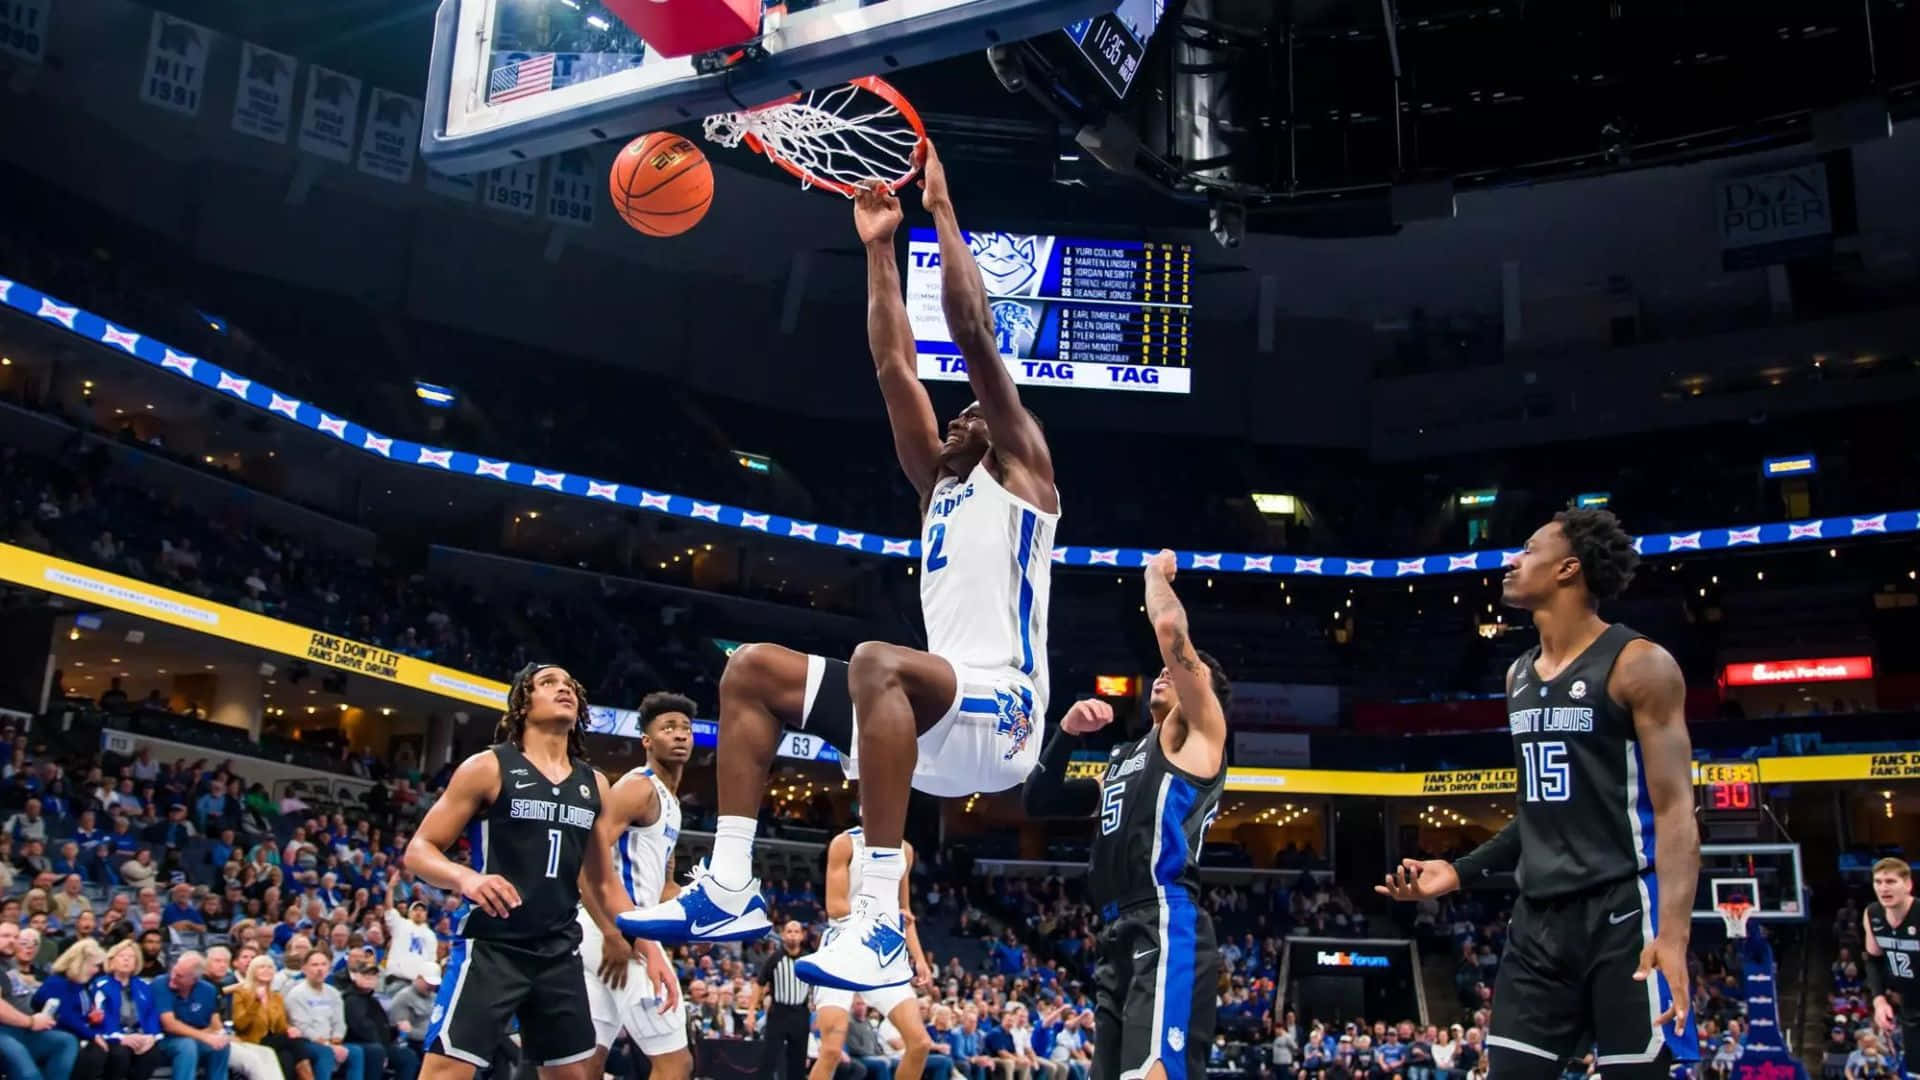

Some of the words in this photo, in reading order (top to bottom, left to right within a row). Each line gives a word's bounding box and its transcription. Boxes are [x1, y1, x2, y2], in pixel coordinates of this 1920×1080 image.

[1094, 20, 1125, 65] 11:35
[154, 55, 196, 85] NIT
[651, 141, 697, 171] ELITE
[553, 178, 593, 201] NIT
[1723, 199, 1824, 236] POIER
[911, 251, 941, 268] TA
[1075, 247, 1092, 256] YURI
[1093, 248, 1124, 258] COLLINS
[1075, 257, 1105, 268] MARTEN
[1074, 268, 1103, 278] JORDAN
[1105, 269, 1134, 280] NESBITT
[1073, 288, 1107, 299] DEANDRE
[1109, 290, 1132, 300] JONES
[1072, 310, 1089, 319] EARL
[1090, 311, 1130, 322] TIMBERLAKE
[1072, 321, 1095, 330] JALEN
[1095, 322, 1121, 332] DUREN
[1072, 331, 1095, 340] TYLER
[1096, 332, 1123, 342] HARRIS
[1072, 341, 1090, 351] JOSH
[1092, 342, 1118, 352] MINOTT
[936, 357, 968, 373] TA
[1021, 361, 1074, 380] TAG
[1107, 366, 1159, 384] TAG
[927, 523, 949, 573] 2
[307, 646, 334, 663] FANS
[335, 653, 363, 670] DRIVE
[365, 661, 399, 679] DRUNK
[311, 633, 341, 651] FANS
[343, 641, 379, 662] DON'T
[379, 651, 400, 668] LET
[1543, 707, 1594, 732] LOUIS
[792, 736, 810, 757] 63
[1521, 741, 1570, 802] 15
[1870, 767, 1901, 777] FANS
[1871, 755, 1908, 767] FANS
[1423, 783, 1448, 793] FANS
[1449, 783, 1478, 792] DRIVE
[1424, 773, 1453, 784] FANS
[1456, 771, 1493, 783] DON'T
[1495, 771, 1516, 780] LET
[1714, 781, 1749, 808] 30
[510, 799, 558, 821] SAINT
[558, 803, 596, 831] LOUIS
[1102, 782, 1126, 837] 5
[545, 829, 562, 878] 1
[1886, 951, 1915, 978] 12
